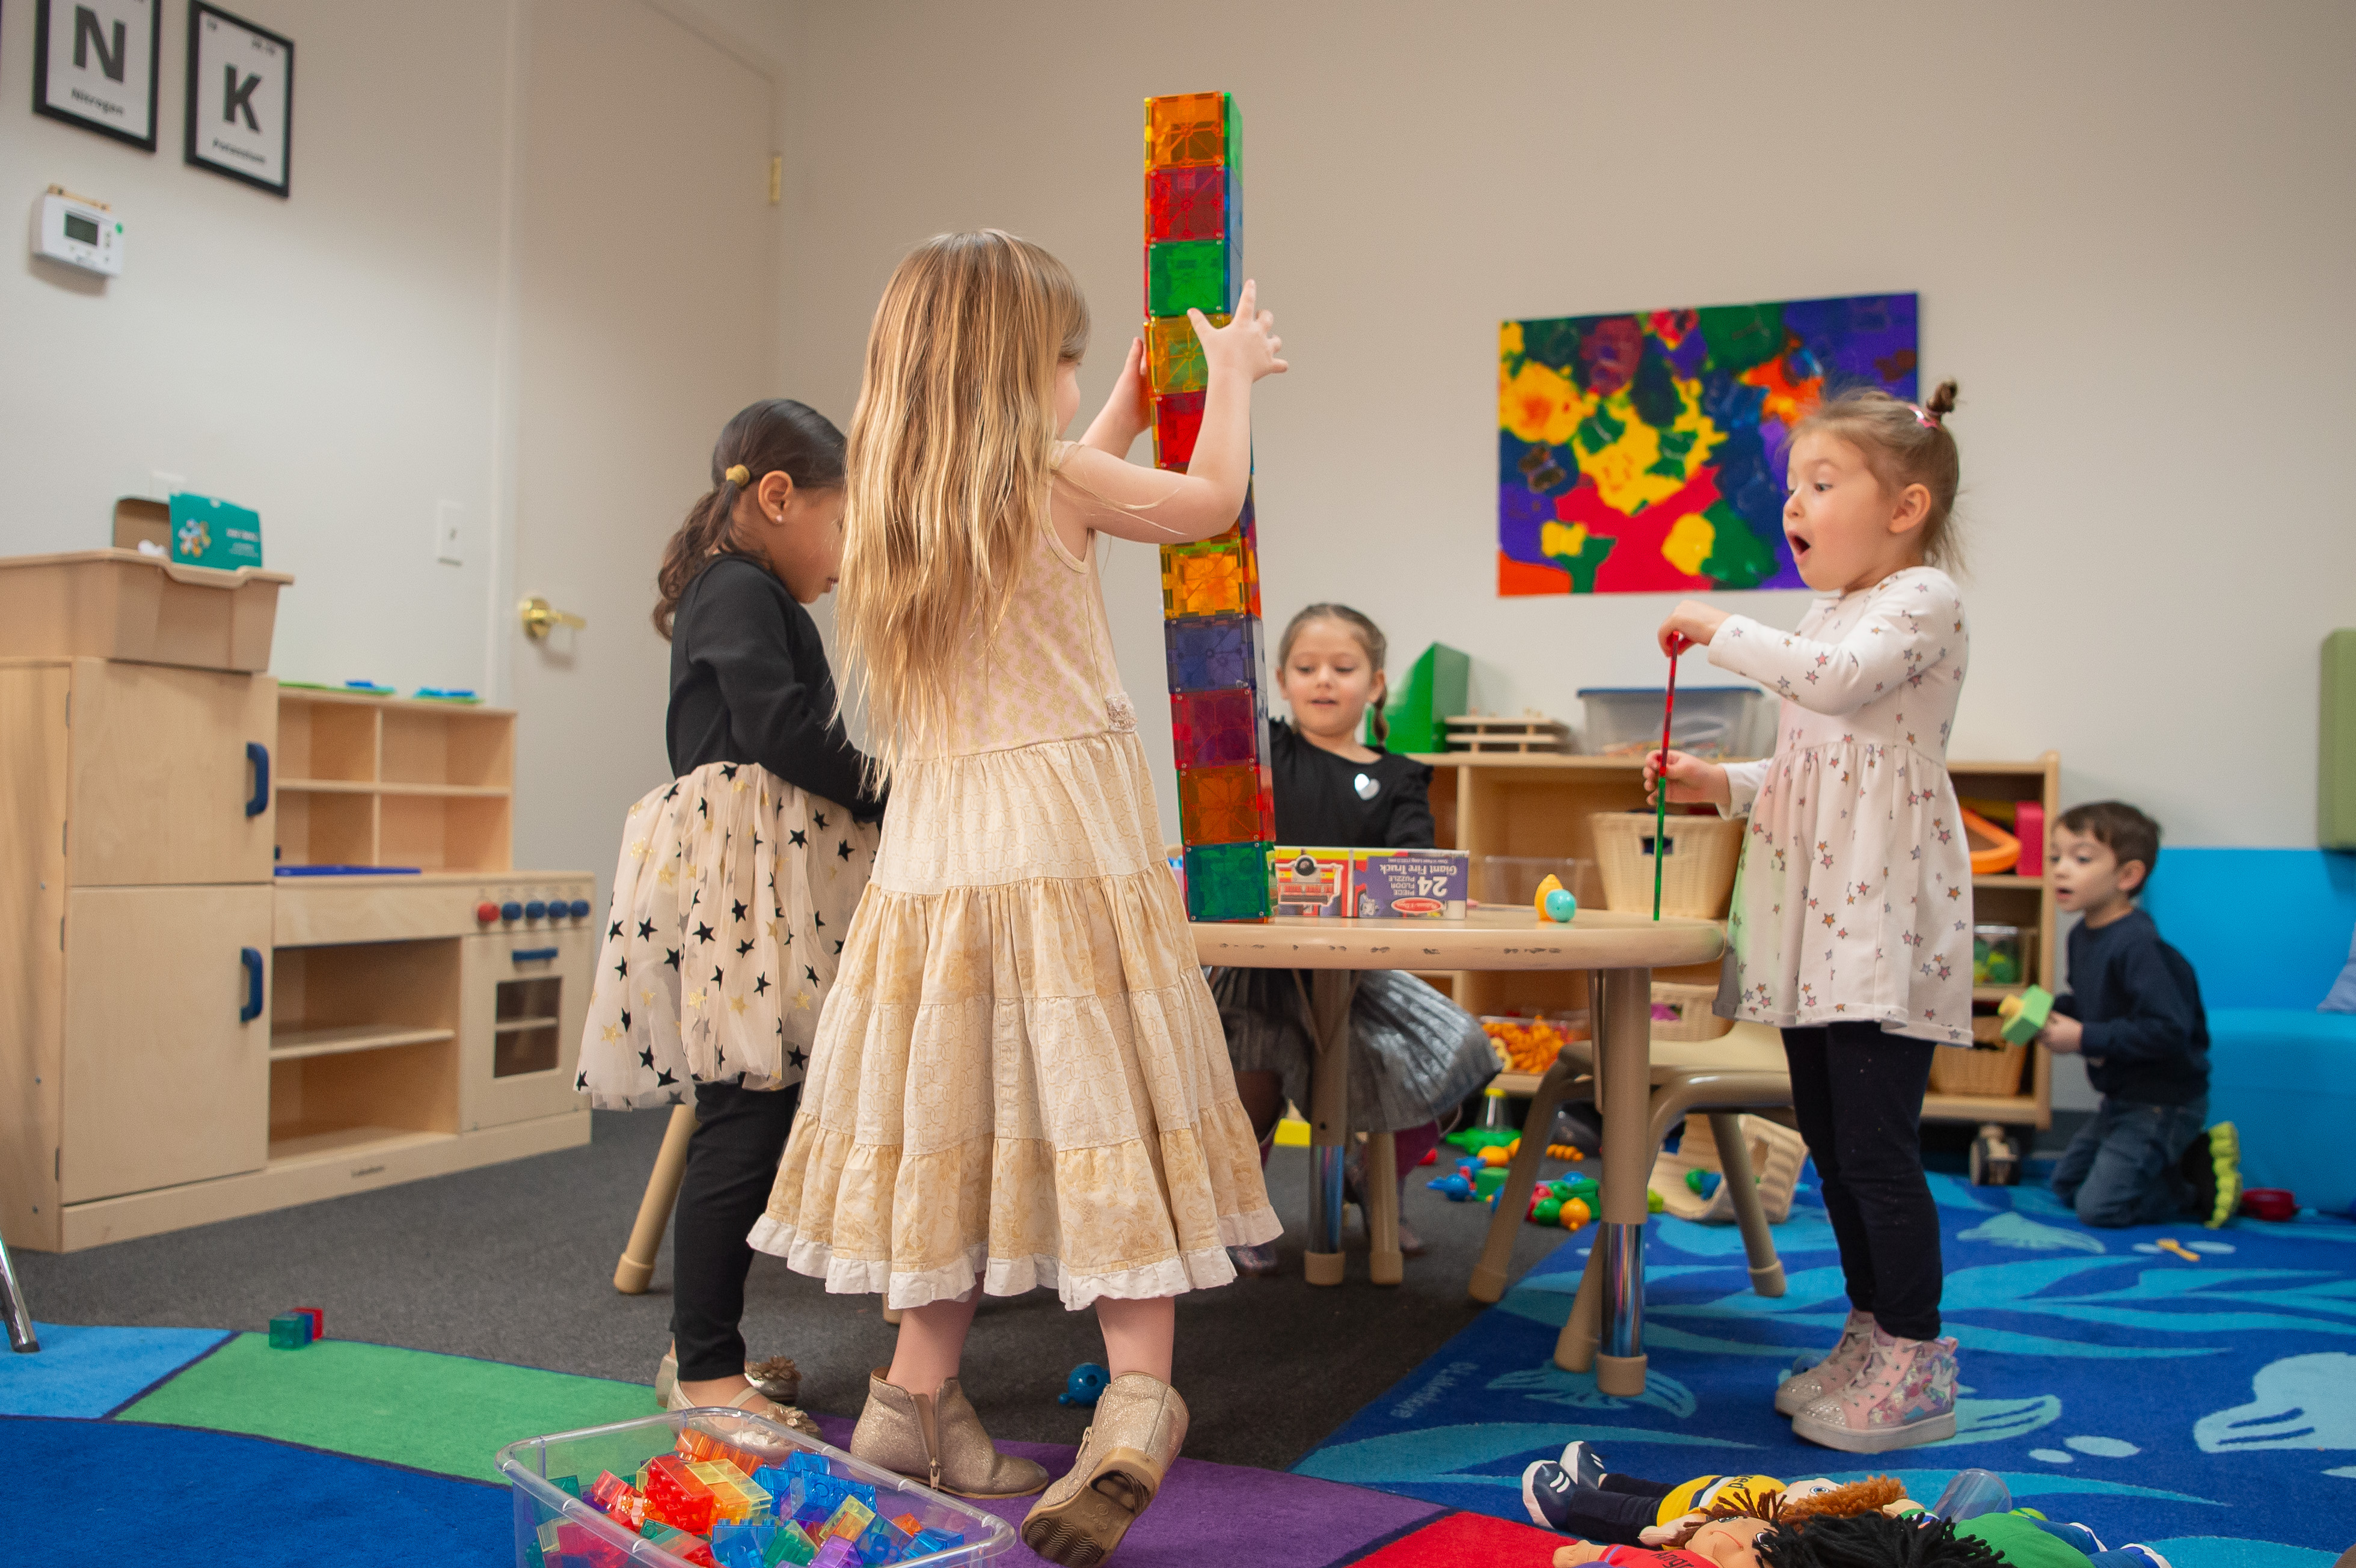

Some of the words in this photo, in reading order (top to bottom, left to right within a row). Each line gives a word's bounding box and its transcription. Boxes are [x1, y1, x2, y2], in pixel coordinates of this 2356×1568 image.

[73, 5, 126, 84] N
[70, 87, 124, 114] Nitrogen
[223, 63, 261, 133] K
[1380, 865, 1407, 875] Truck
[1408, 865, 1426, 875] Fire
[1430, 865, 1458, 875] Giant
[1417, 876, 1448, 896] 24
